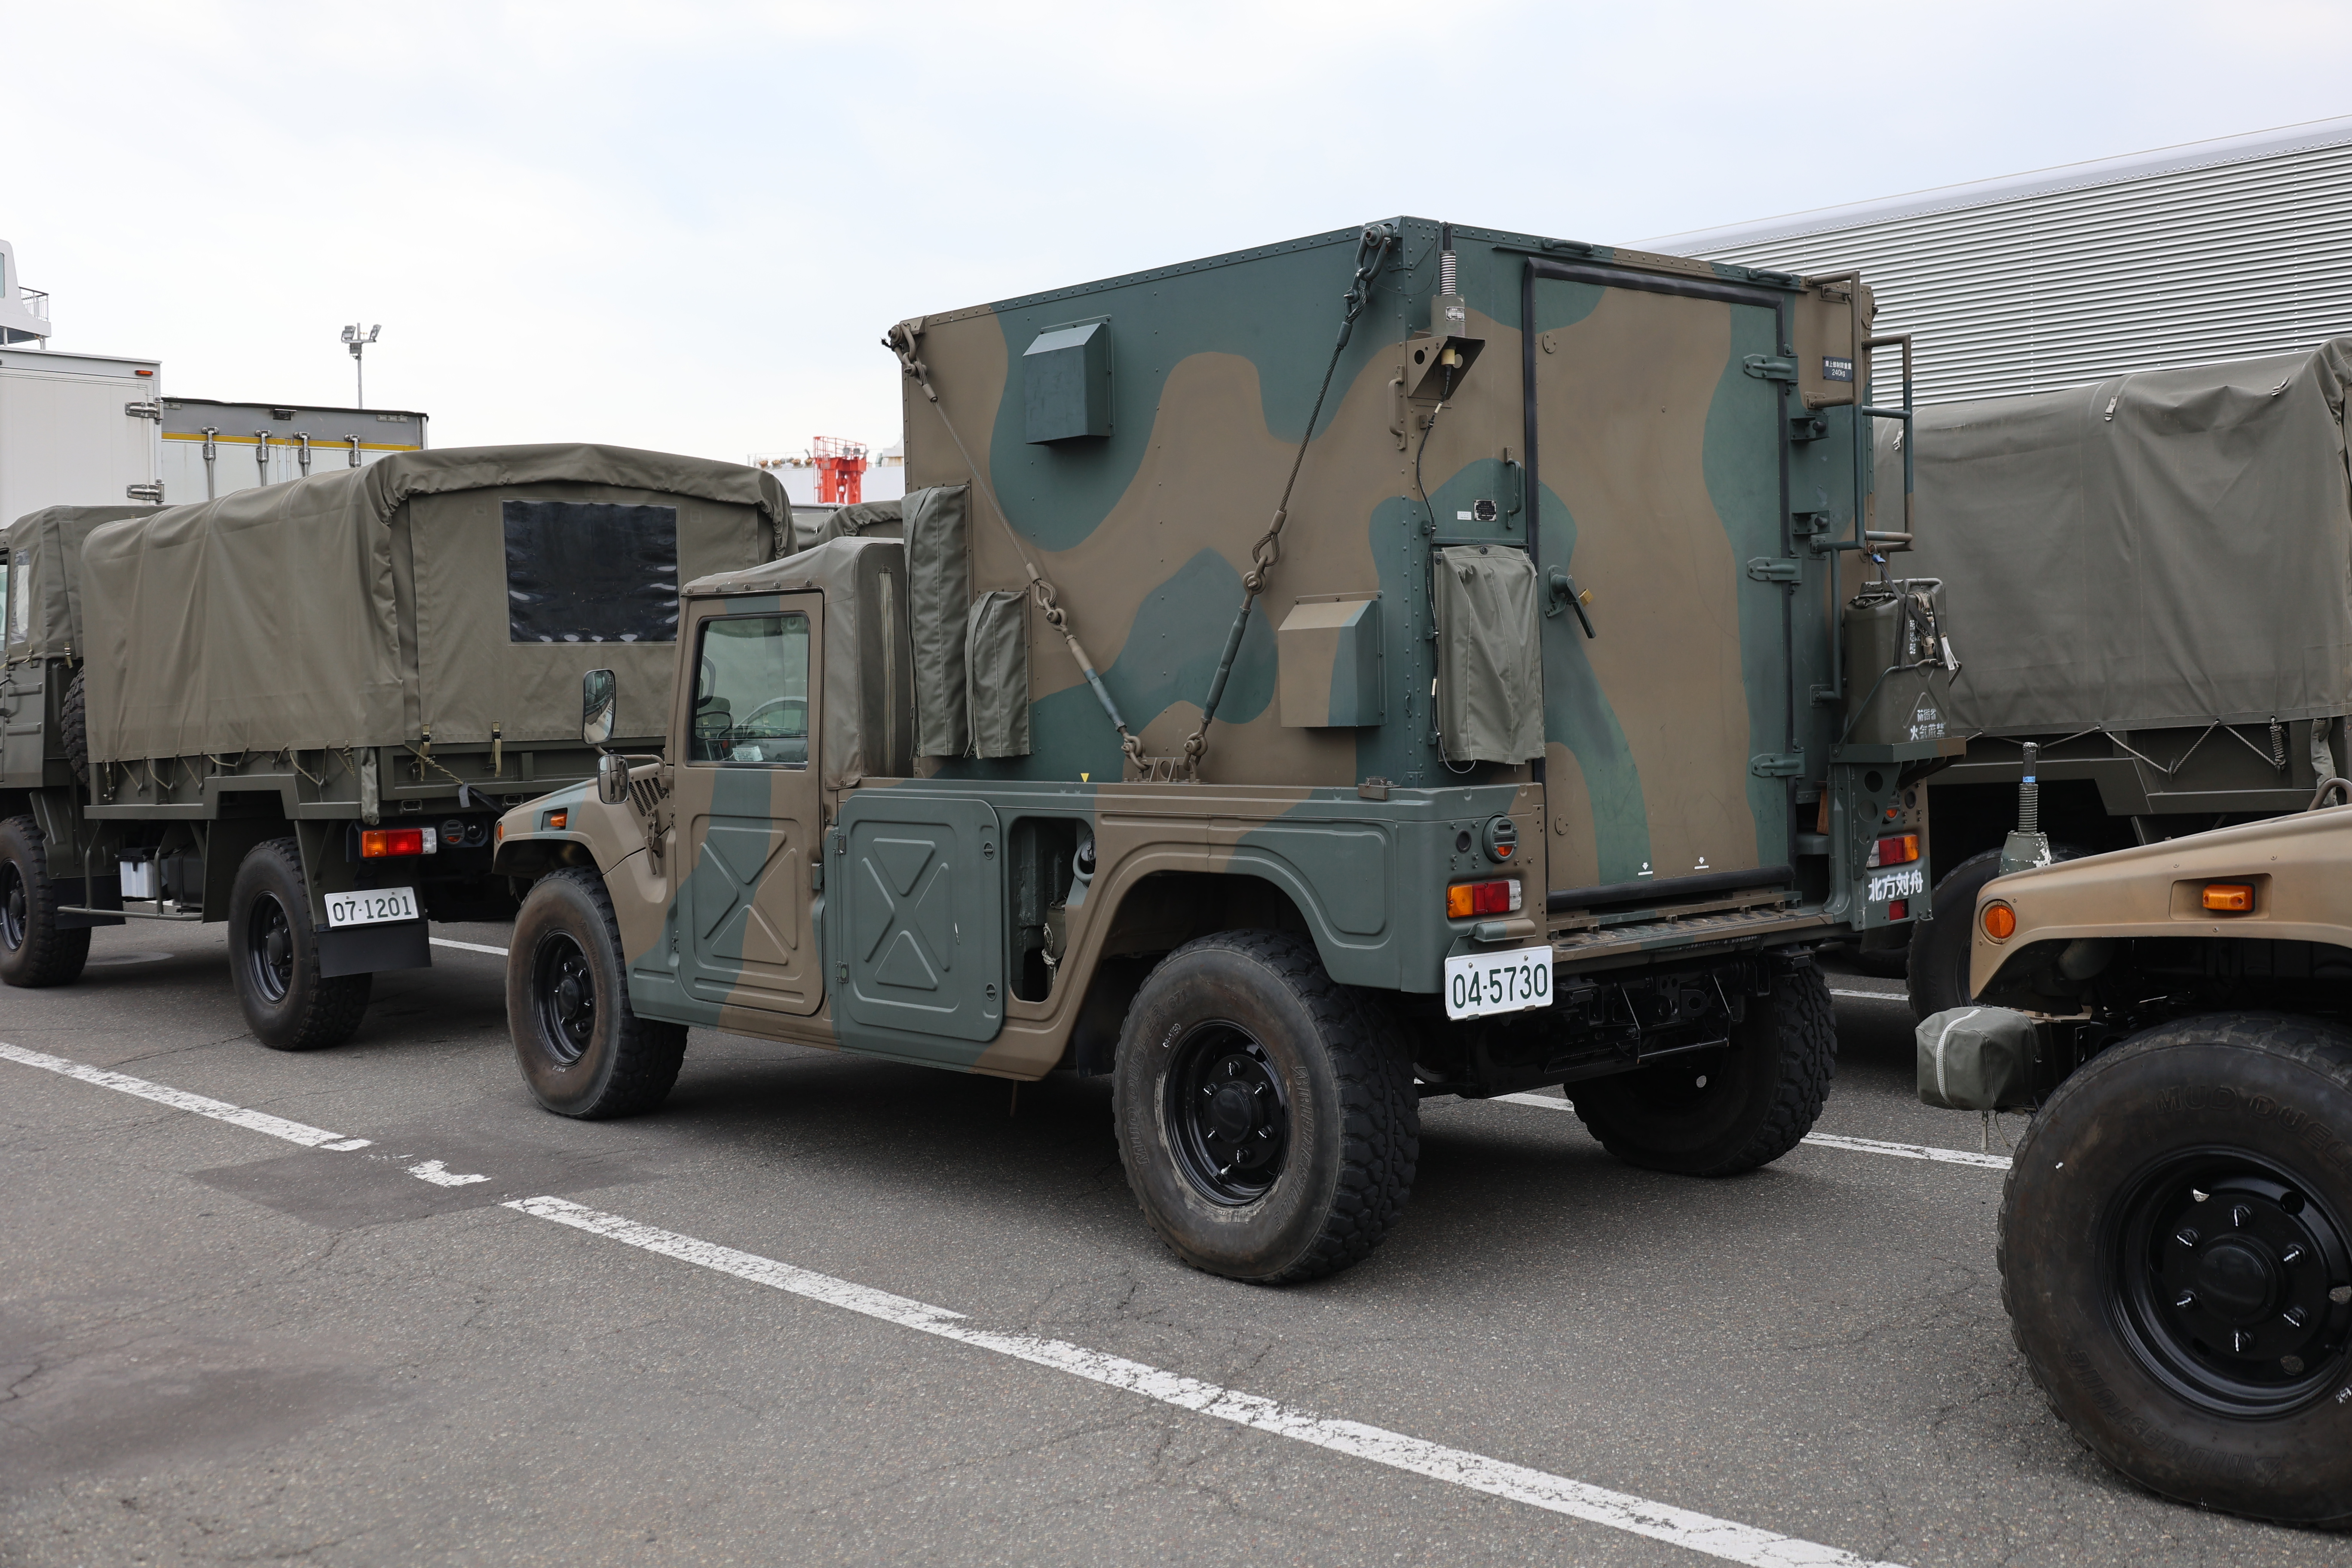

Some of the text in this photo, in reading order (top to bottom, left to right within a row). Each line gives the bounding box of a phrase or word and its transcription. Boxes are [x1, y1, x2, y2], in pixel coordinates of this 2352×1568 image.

[1825, 360, 1852, 370] 屋上部制限重量
[1831, 369, 1846, 377] 240kg
[1917, 708, 1936, 722] 防衛省
[1910, 723, 1945, 741] 火気厳禁
[1868, 869, 1923, 902] 北方対舟
[332, 896, 412, 922] 07-1201
[1167, 988, 1188, 1009] 671
[1453, 963, 1547, 1008] 04-5730
[1127, 1003, 1165, 1102] DUELER
[2155, 1084, 2238, 1115] MUD
[1127, 1107, 1150, 1166] MUD
[1274, 1066, 1314, 1232] BRIDGESTONE
